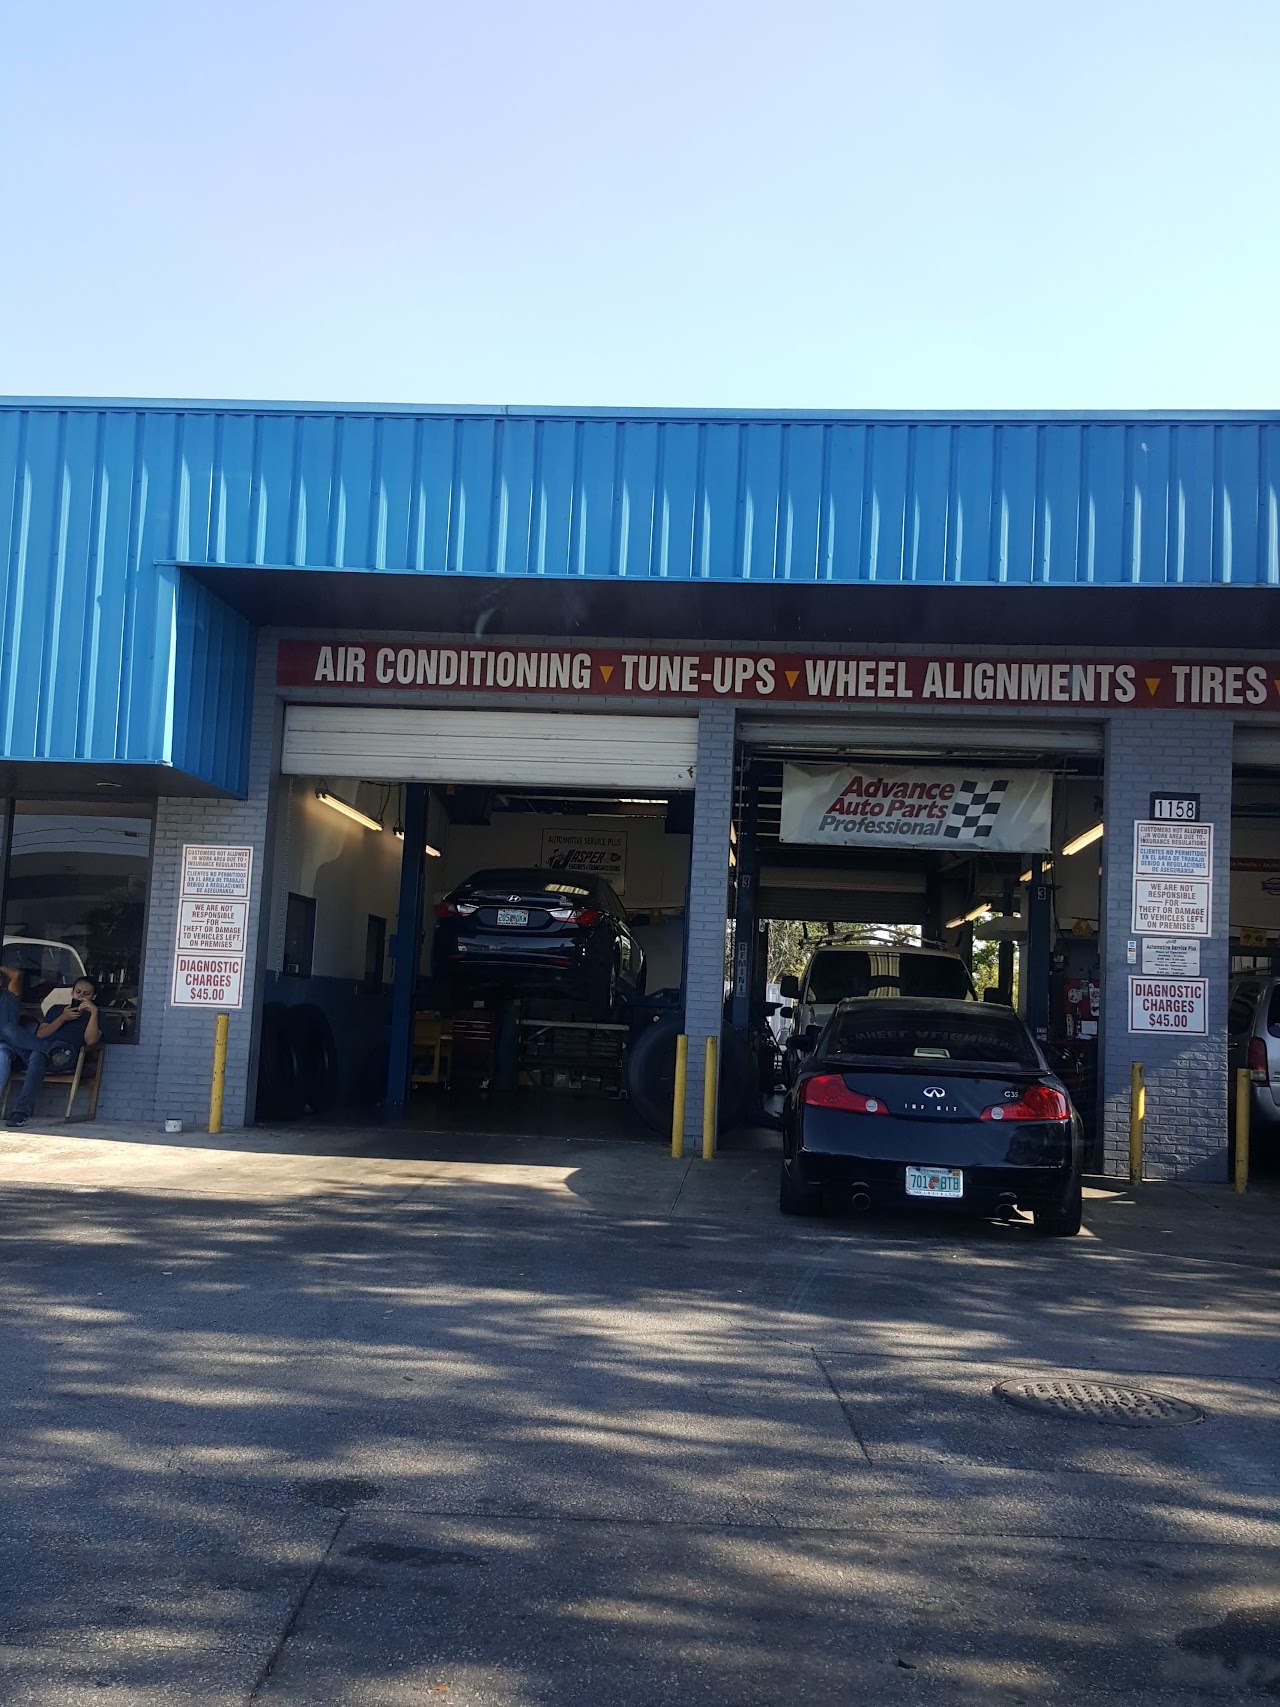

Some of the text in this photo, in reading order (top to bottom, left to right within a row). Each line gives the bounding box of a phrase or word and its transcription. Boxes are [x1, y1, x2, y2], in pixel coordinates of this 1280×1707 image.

[315, 646, 1266, 704] AIR CONDITIONING TUNE-UPS WHEEL ALIGNMENTS TIRES
[841, 776, 955, 800] Advance
[826, 798, 948, 819] Auto Parts
[1158, 801, 1195, 818] 1158
[819, 815, 943, 835] Professional
[549, 836, 582, 844] AUTOMOTIVE
[565, 850, 605, 870] JASPER
[1039, 888, 1044, 898] 3
[1148, 891, 1196, 899] RESPONSIBLE
[180, 960, 239, 973] DIAGNOSTIC
[739, 944, 747, 992] GEMINI
[186, 974, 231, 987] CHARGES
[190, 987, 224, 1000] $45.00
[1136, 984, 1201, 998] DIAGNOSTIC
[1143, 999, 1194, 1013] CHARGES
[1149, 1013, 1187, 1027] $45.00
[911, 1174, 927, 1188] 701
